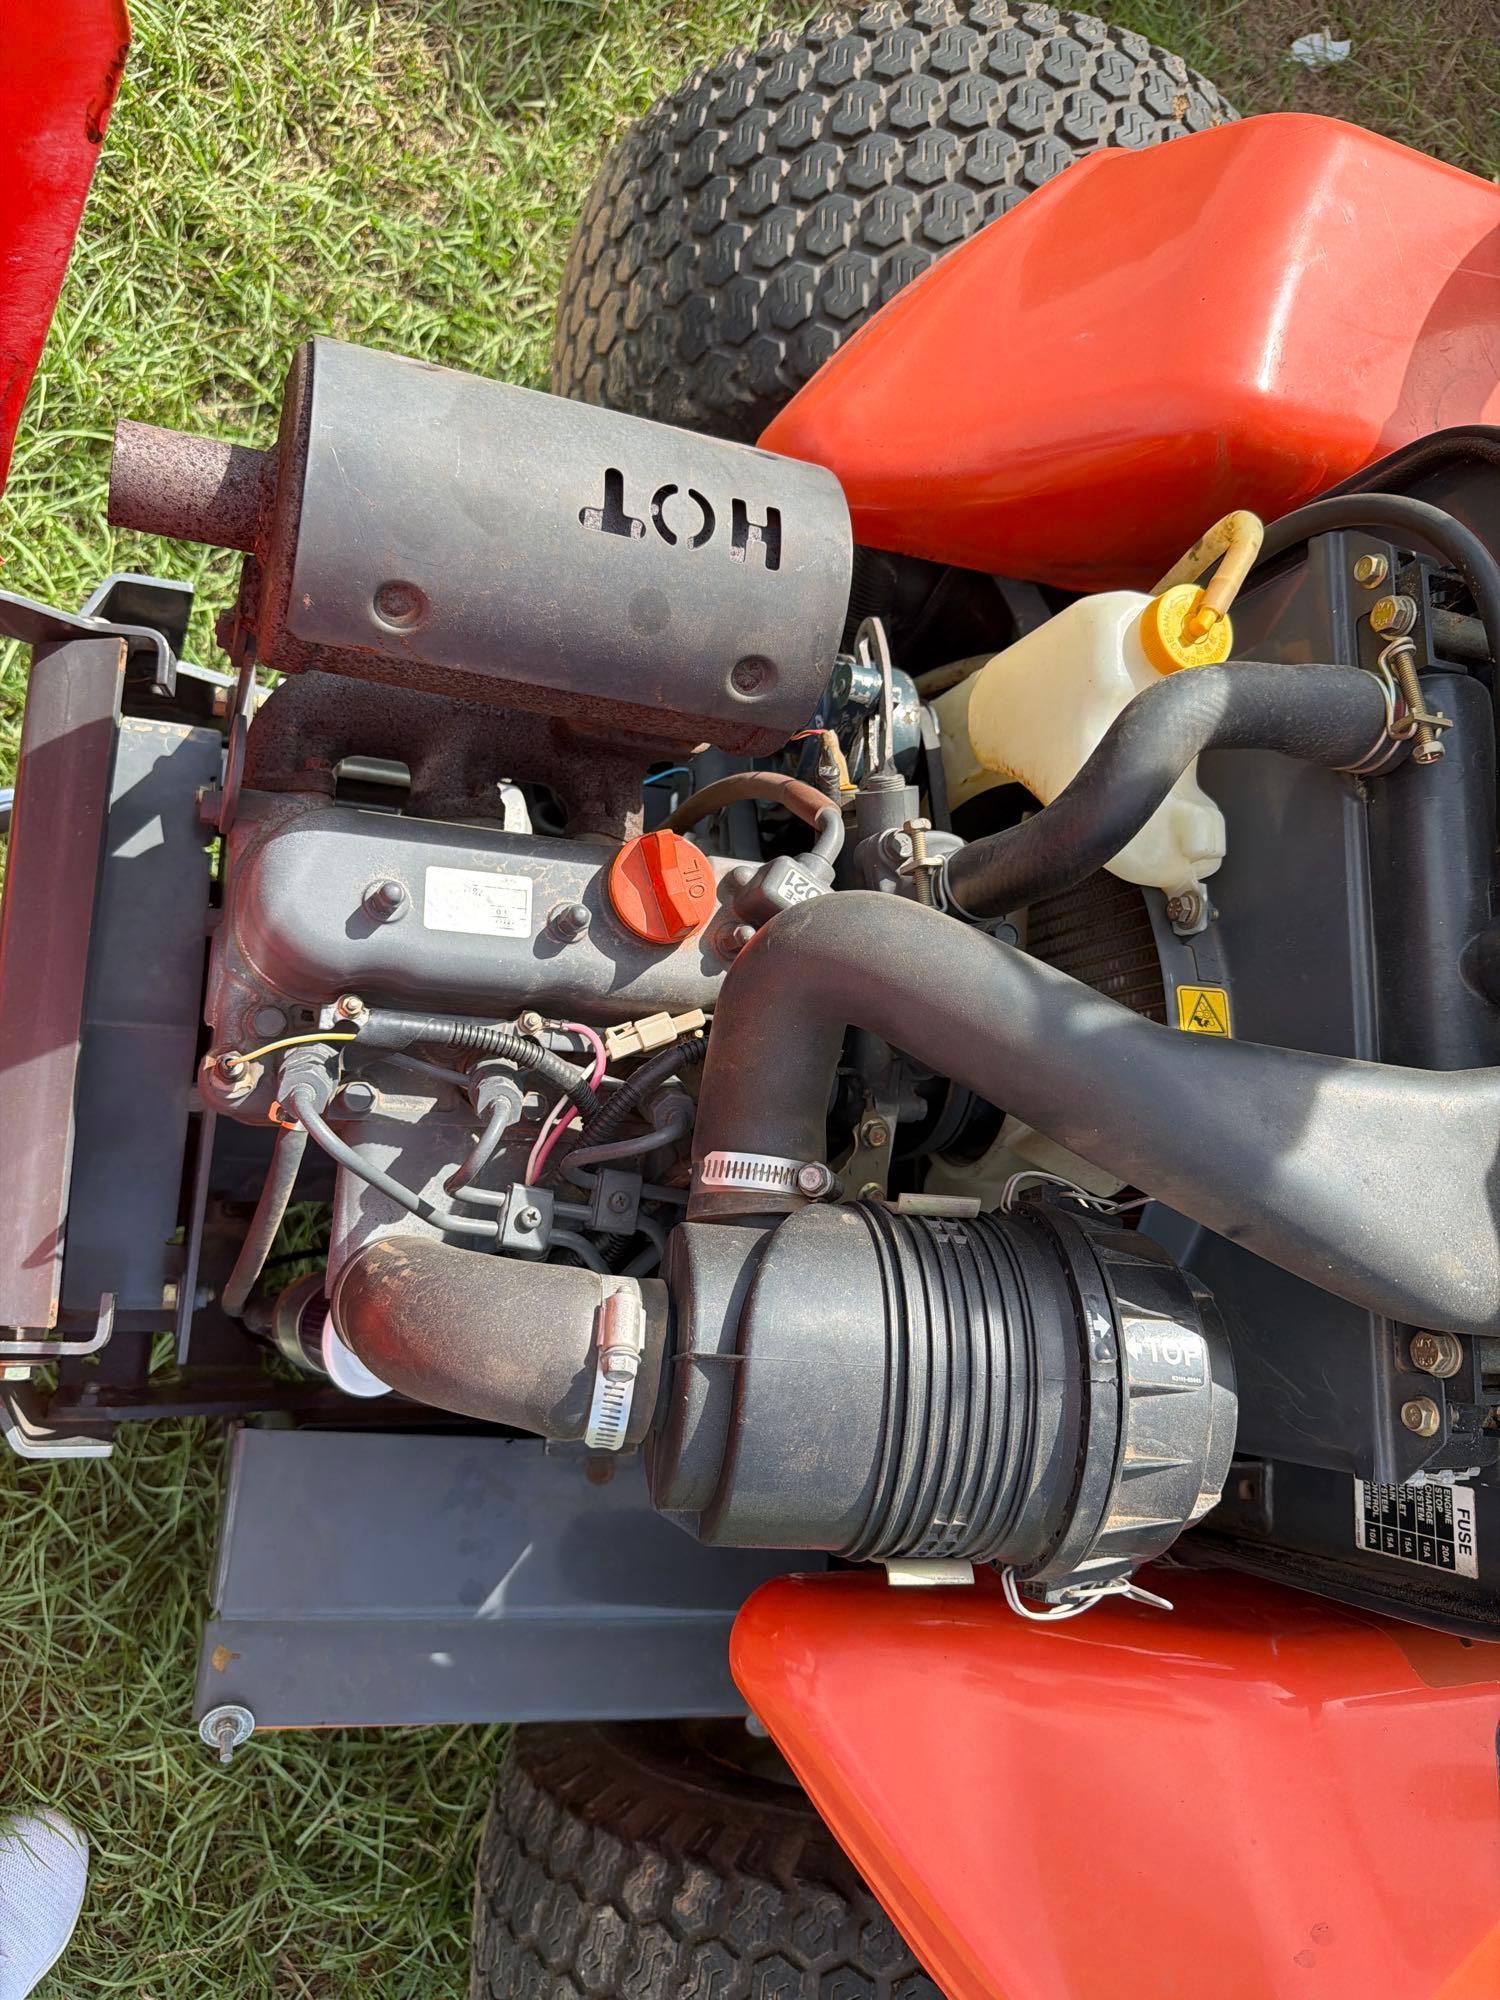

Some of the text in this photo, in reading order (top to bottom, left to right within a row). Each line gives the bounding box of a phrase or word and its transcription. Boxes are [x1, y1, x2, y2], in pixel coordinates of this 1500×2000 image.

[578, 467, 782, 572] HOT
[682, 858, 705, 899] OIL
[1371, 1481, 1380, 1518] ONTROL
[1380, 1482, 1389, 1514] YSTEM
[1388, 1482, 1396, 1501] AIN
[1417, 1486, 1425, 1522] SYSTEM
[1424, 1484, 1433, 1525] CHARGE
[1434, 1487, 1444, 1513] STOP
[1443, 1488, 1453, 1525] ENGINE
[1386, 1532, 1394, 1549] 15A
[1404, 1536, 1412, 1553] 15A
[1456, 1507, 1473, 1556] FUSE
[1423, 1541, 1431, 1558] 15A
[1441, 1544, 1450, 1563] 20A
